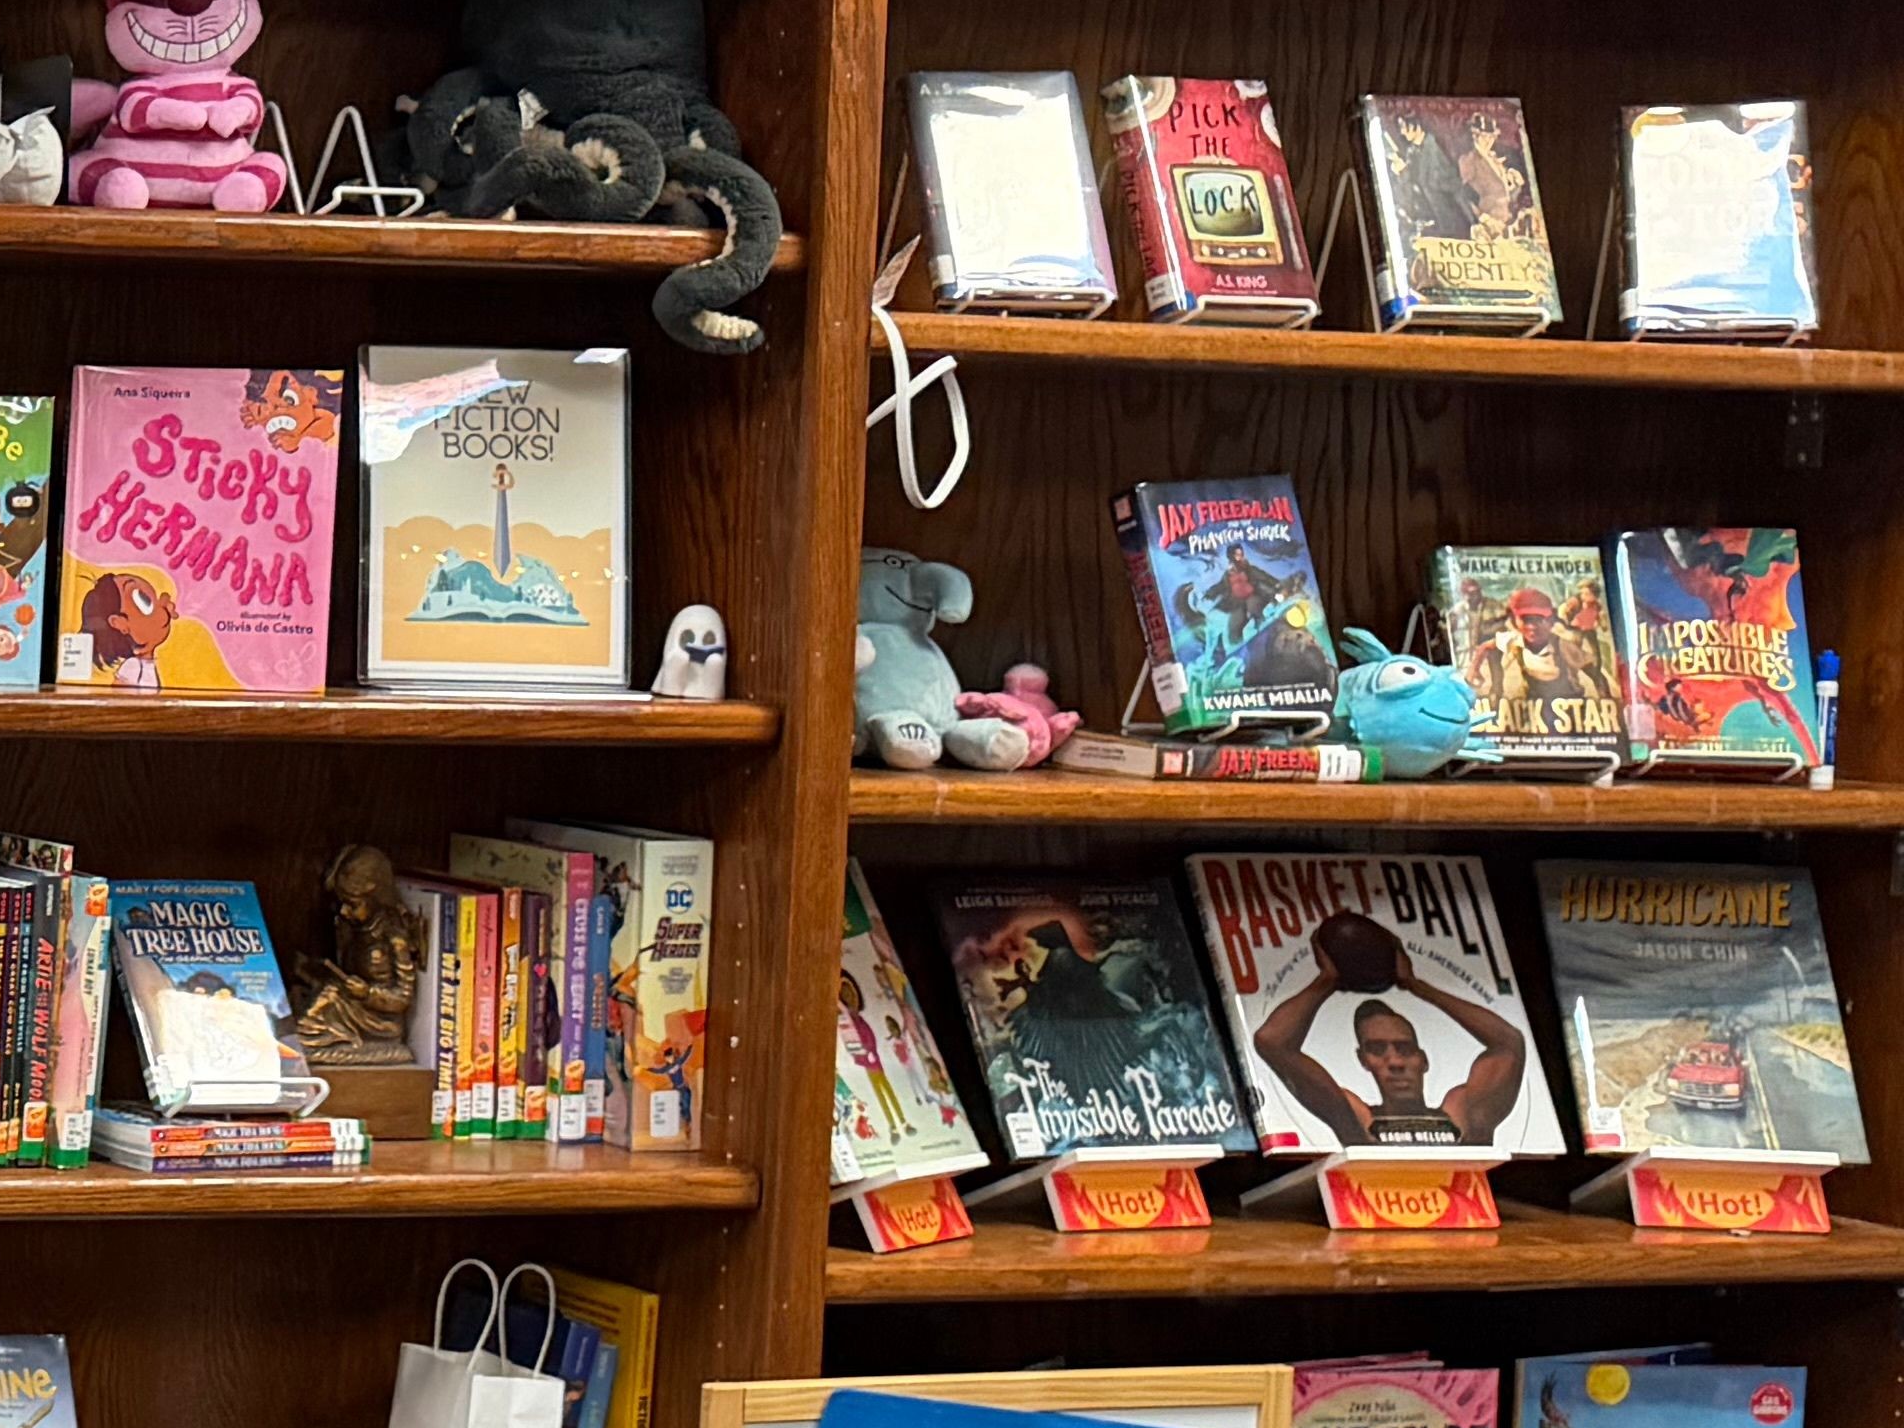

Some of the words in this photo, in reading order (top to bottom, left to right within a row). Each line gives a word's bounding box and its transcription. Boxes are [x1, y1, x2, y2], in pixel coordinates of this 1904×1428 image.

[1169, 102, 1242, 133] PICK
[1192, 134, 1232, 158] THE
[1187, 183, 1257, 215] LOCK
[441, 432, 554, 462] BOOKS!
[1158, 503, 1195, 549] JAX
[1198, 496, 1295, 526] FREEMAN
[78, 470, 313, 607] HERMANA
[216, 621, 252, 633] Olivia
[255, 622, 269, 633] de
[273, 622, 313, 634] Castro
[1639, 618, 1788, 652] IMPOSSIBLE
[1637, 646, 1796, 691] CREATURES
[1204, 693, 1267, 711] KWAME
[1270, 688, 1332, 709] MBALIA
[1552, 698, 1620, 733] STAR
[666, 888, 694, 907] DC
[1560, 876, 1792, 928] HURRICANE
[148, 900, 230, 927] MAGIC
[1381, 860, 1514, 995] BALL
[125, 928, 190, 956] TREE
[194, 928, 264, 955] HOUSE
[655, 916, 702, 941] SUPER
[650, 941, 702, 961] HEROES
[1633, 942, 1692, 960] JASON
[1702, 944, 1748, 960] CHIN
[1023, 1058, 1067, 1101] The
[1004, 1073, 1141, 1143] Invisible
[1124, 1065, 1236, 1139] Parade
[1108, 1189, 1156, 1216] Hot!
[1387, 1189, 1441, 1215] Hot!
[1698, 1191, 1764, 1217] Hot!
